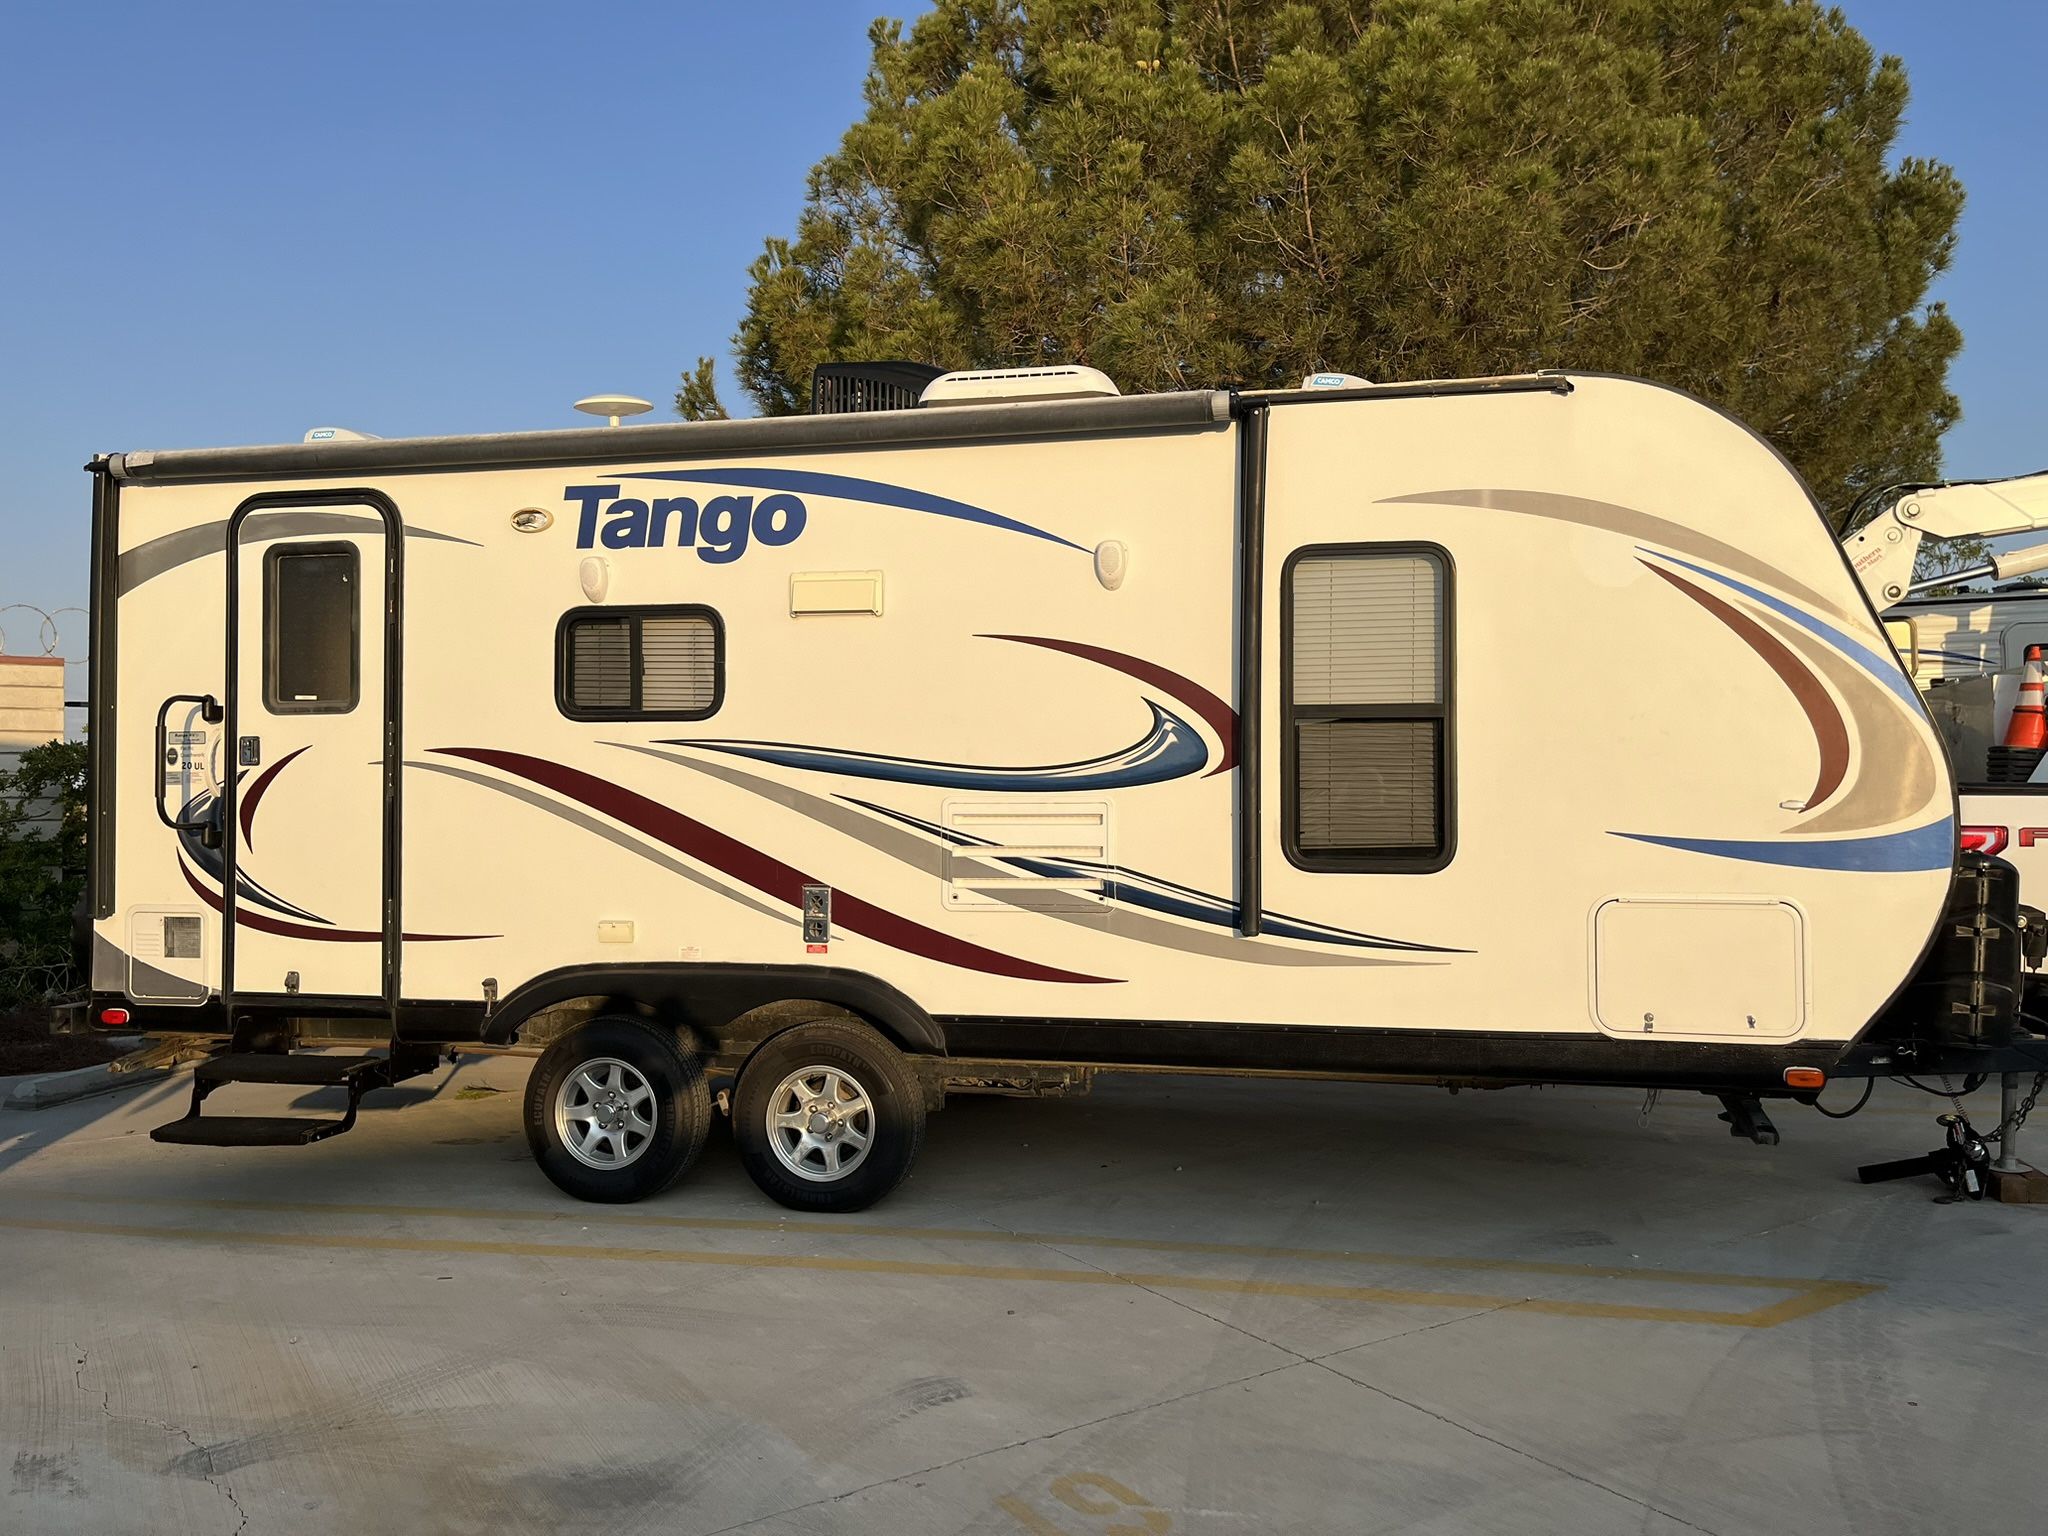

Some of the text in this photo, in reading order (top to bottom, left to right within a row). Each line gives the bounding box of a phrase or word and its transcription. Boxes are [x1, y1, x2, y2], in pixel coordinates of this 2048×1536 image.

[564, 484, 807, 564] Tango
[181, 761, 205, 770] 20 UL
